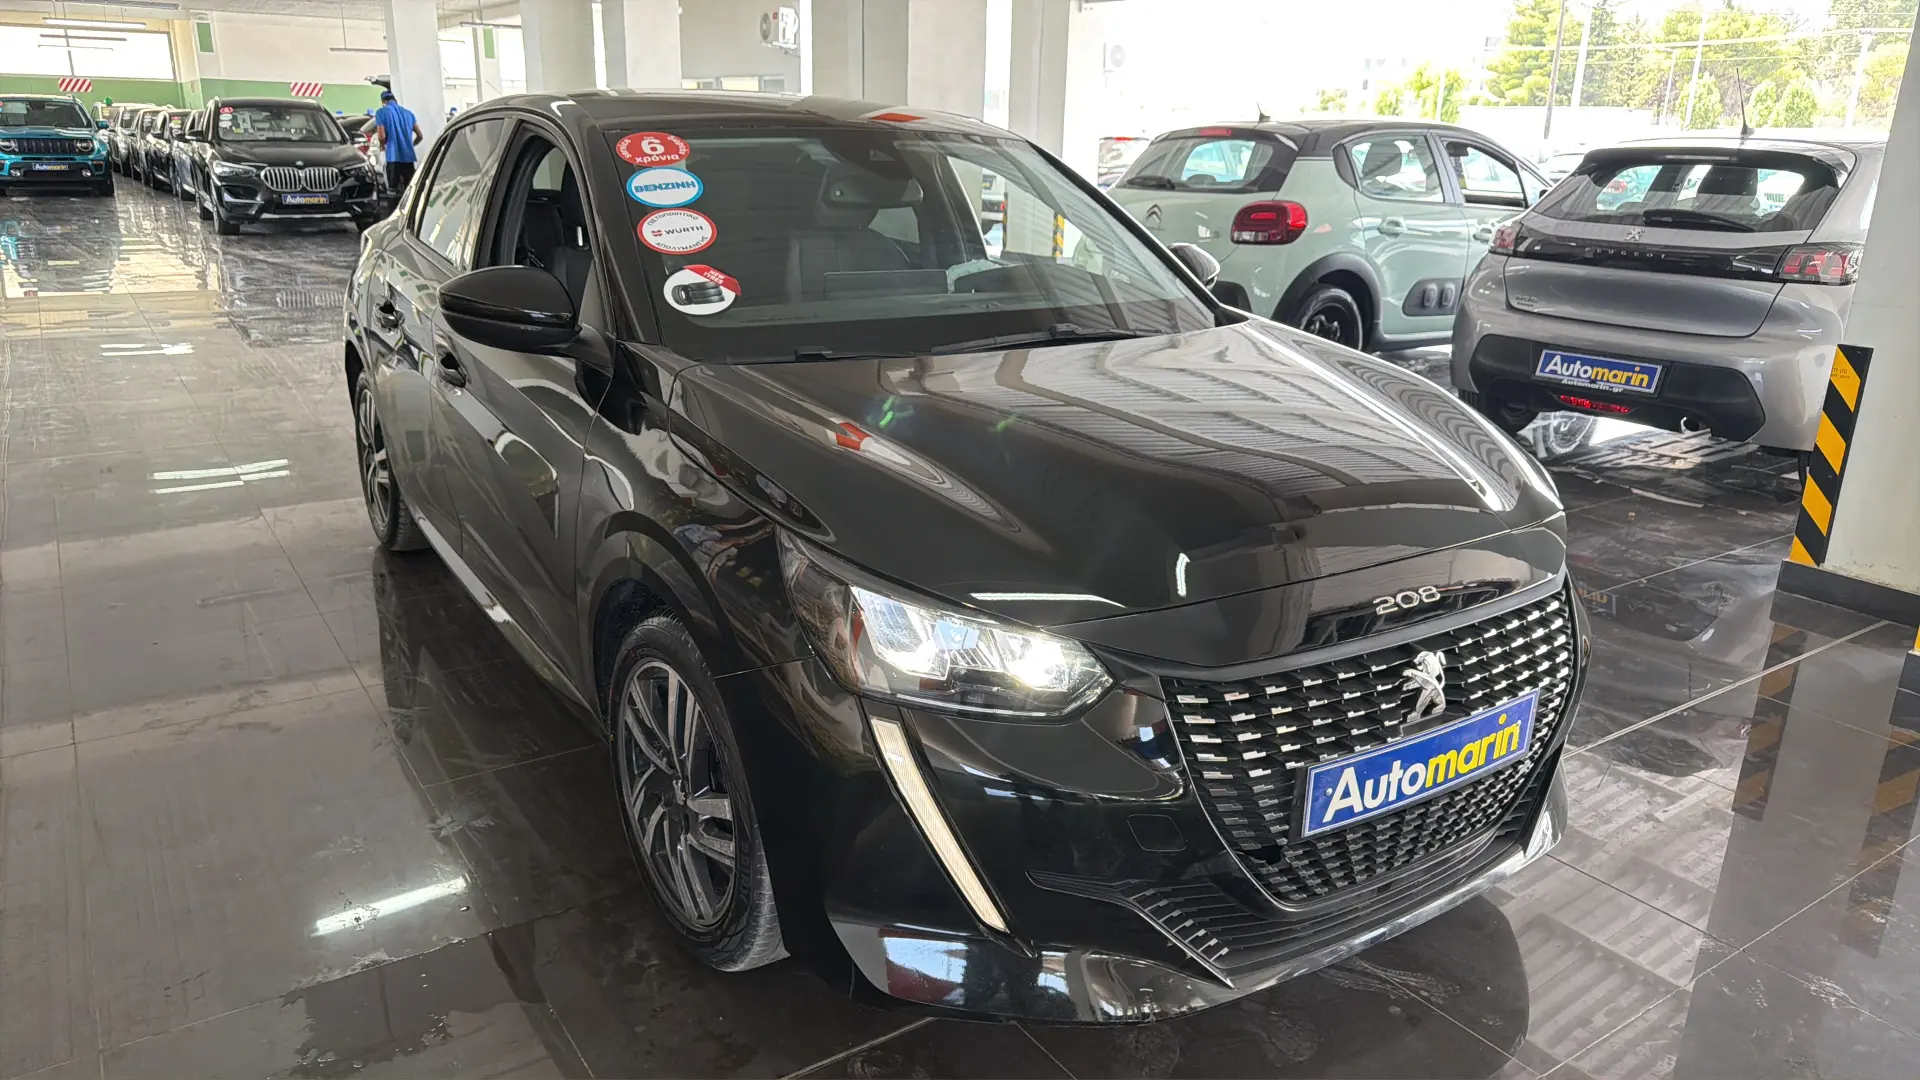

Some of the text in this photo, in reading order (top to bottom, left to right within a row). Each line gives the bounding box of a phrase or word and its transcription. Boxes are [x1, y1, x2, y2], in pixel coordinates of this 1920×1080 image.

[641, 138, 665, 155] 6
[635, 154, 680, 164] χρόνια
[286, 194, 327, 203] Automarin
[1584, 247, 1667, 259] PEUGEOT
[703, 272, 724, 284] TYRES
[709, 269, 726, 280] NEW
[1544, 354, 1649, 388] Automarin
[1561, 379, 1624, 394] Automarin.gr
[1372, 585, 1441, 615] 208
[1321, 713, 1521, 823] Automarin
